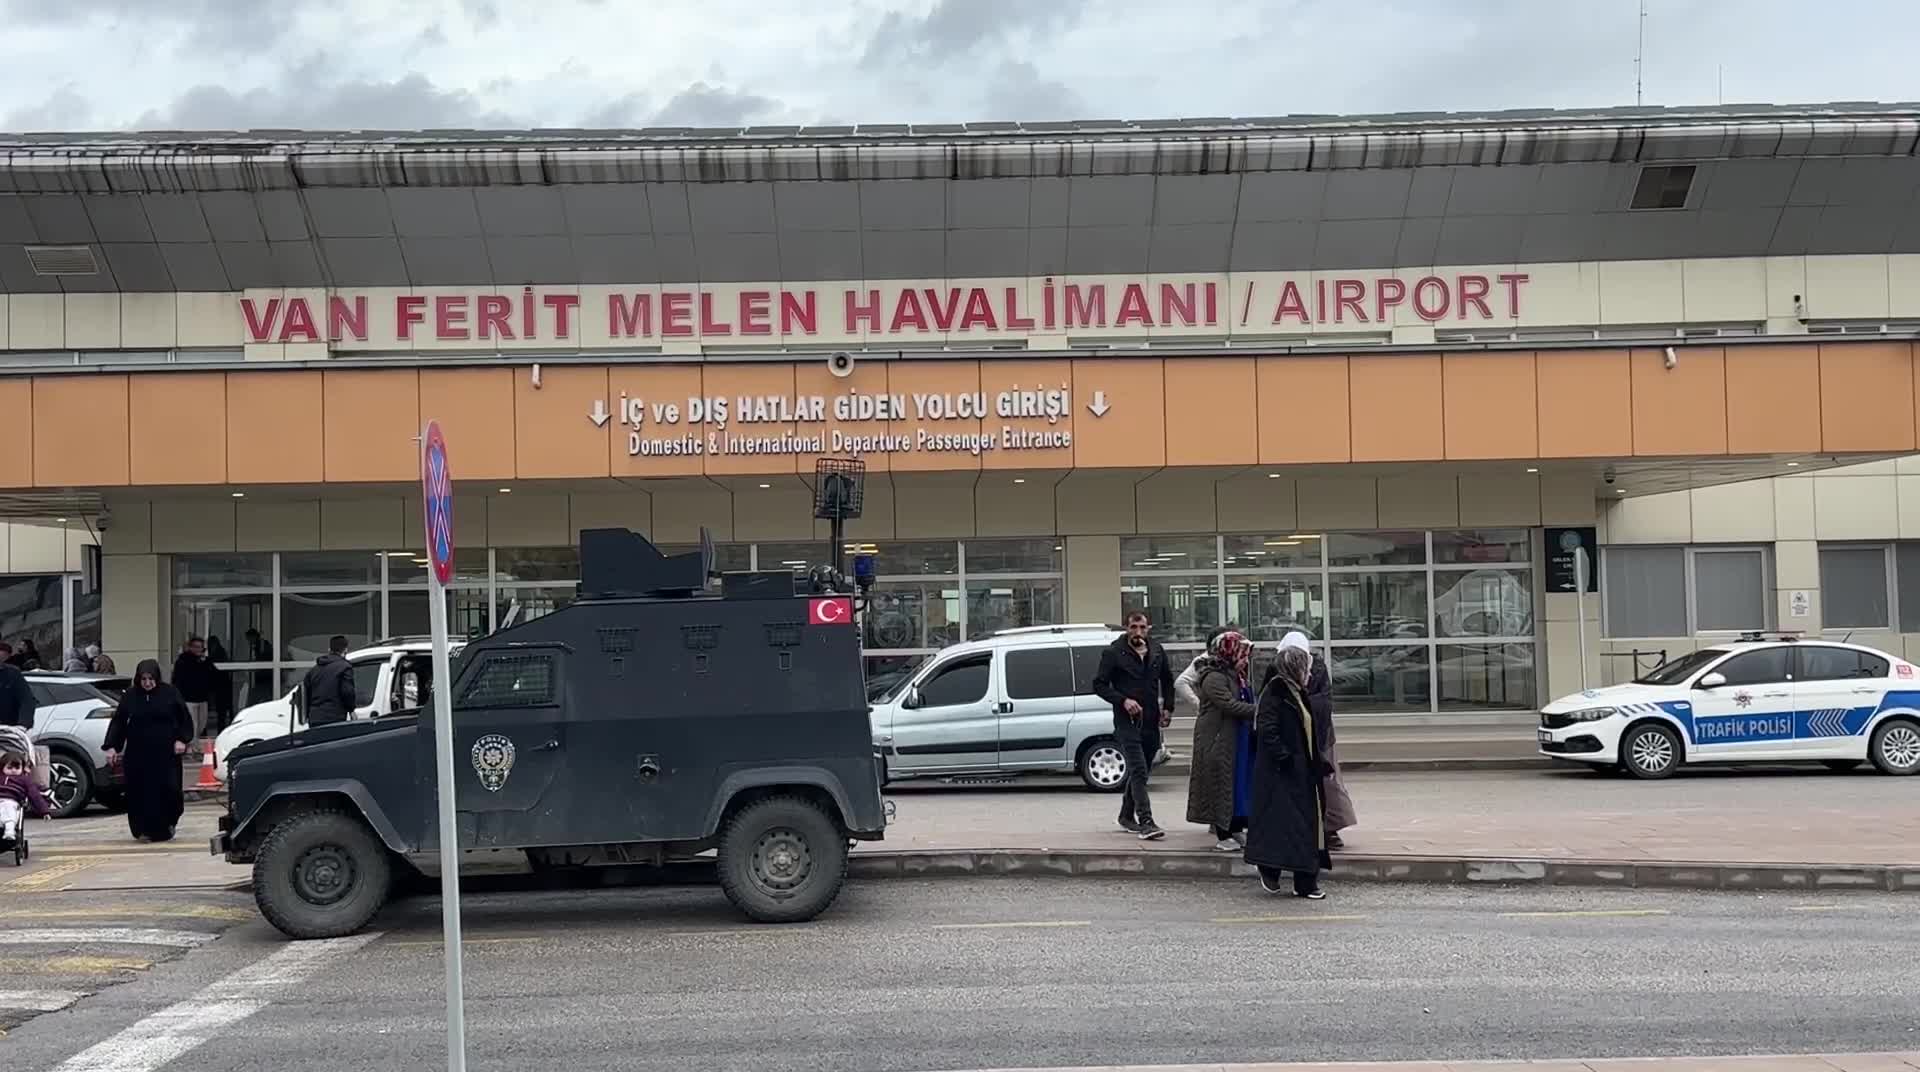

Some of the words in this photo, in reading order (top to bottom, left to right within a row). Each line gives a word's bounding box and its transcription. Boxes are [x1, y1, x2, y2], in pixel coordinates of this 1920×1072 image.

[240, 295, 368, 343] VAN
[396, 286, 581, 341] FERİT
[608, 290, 816, 337] MELEN
[845, 276, 1217, 333] HAVALİMANI
[1272, 274, 1530, 325] AIRPORT
[620, 391, 644, 430] İÇ
[652, 402, 680, 423] ve
[687, 397, 729, 429] DIŞ
[737, 395, 826, 423] HATLAR
[834, 387, 906, 421] GİDEN
[912, 392, 988, 420] YOLCU
[996, 383, 1070, 423] GİRİŞİ
[629, 432, 703, 456] Domestic
[708, 432, 719, 454] &
[724, 430, 825, 454] International
[832, 429, 911, 456] Departure
[917, 428, 997, 455] Passenger
[1002, 425, 1071, 449] Entrance
[1700, 718, 1746, 738] TRAFİK
[1750, 715, 1792, 736] POLİSİ
